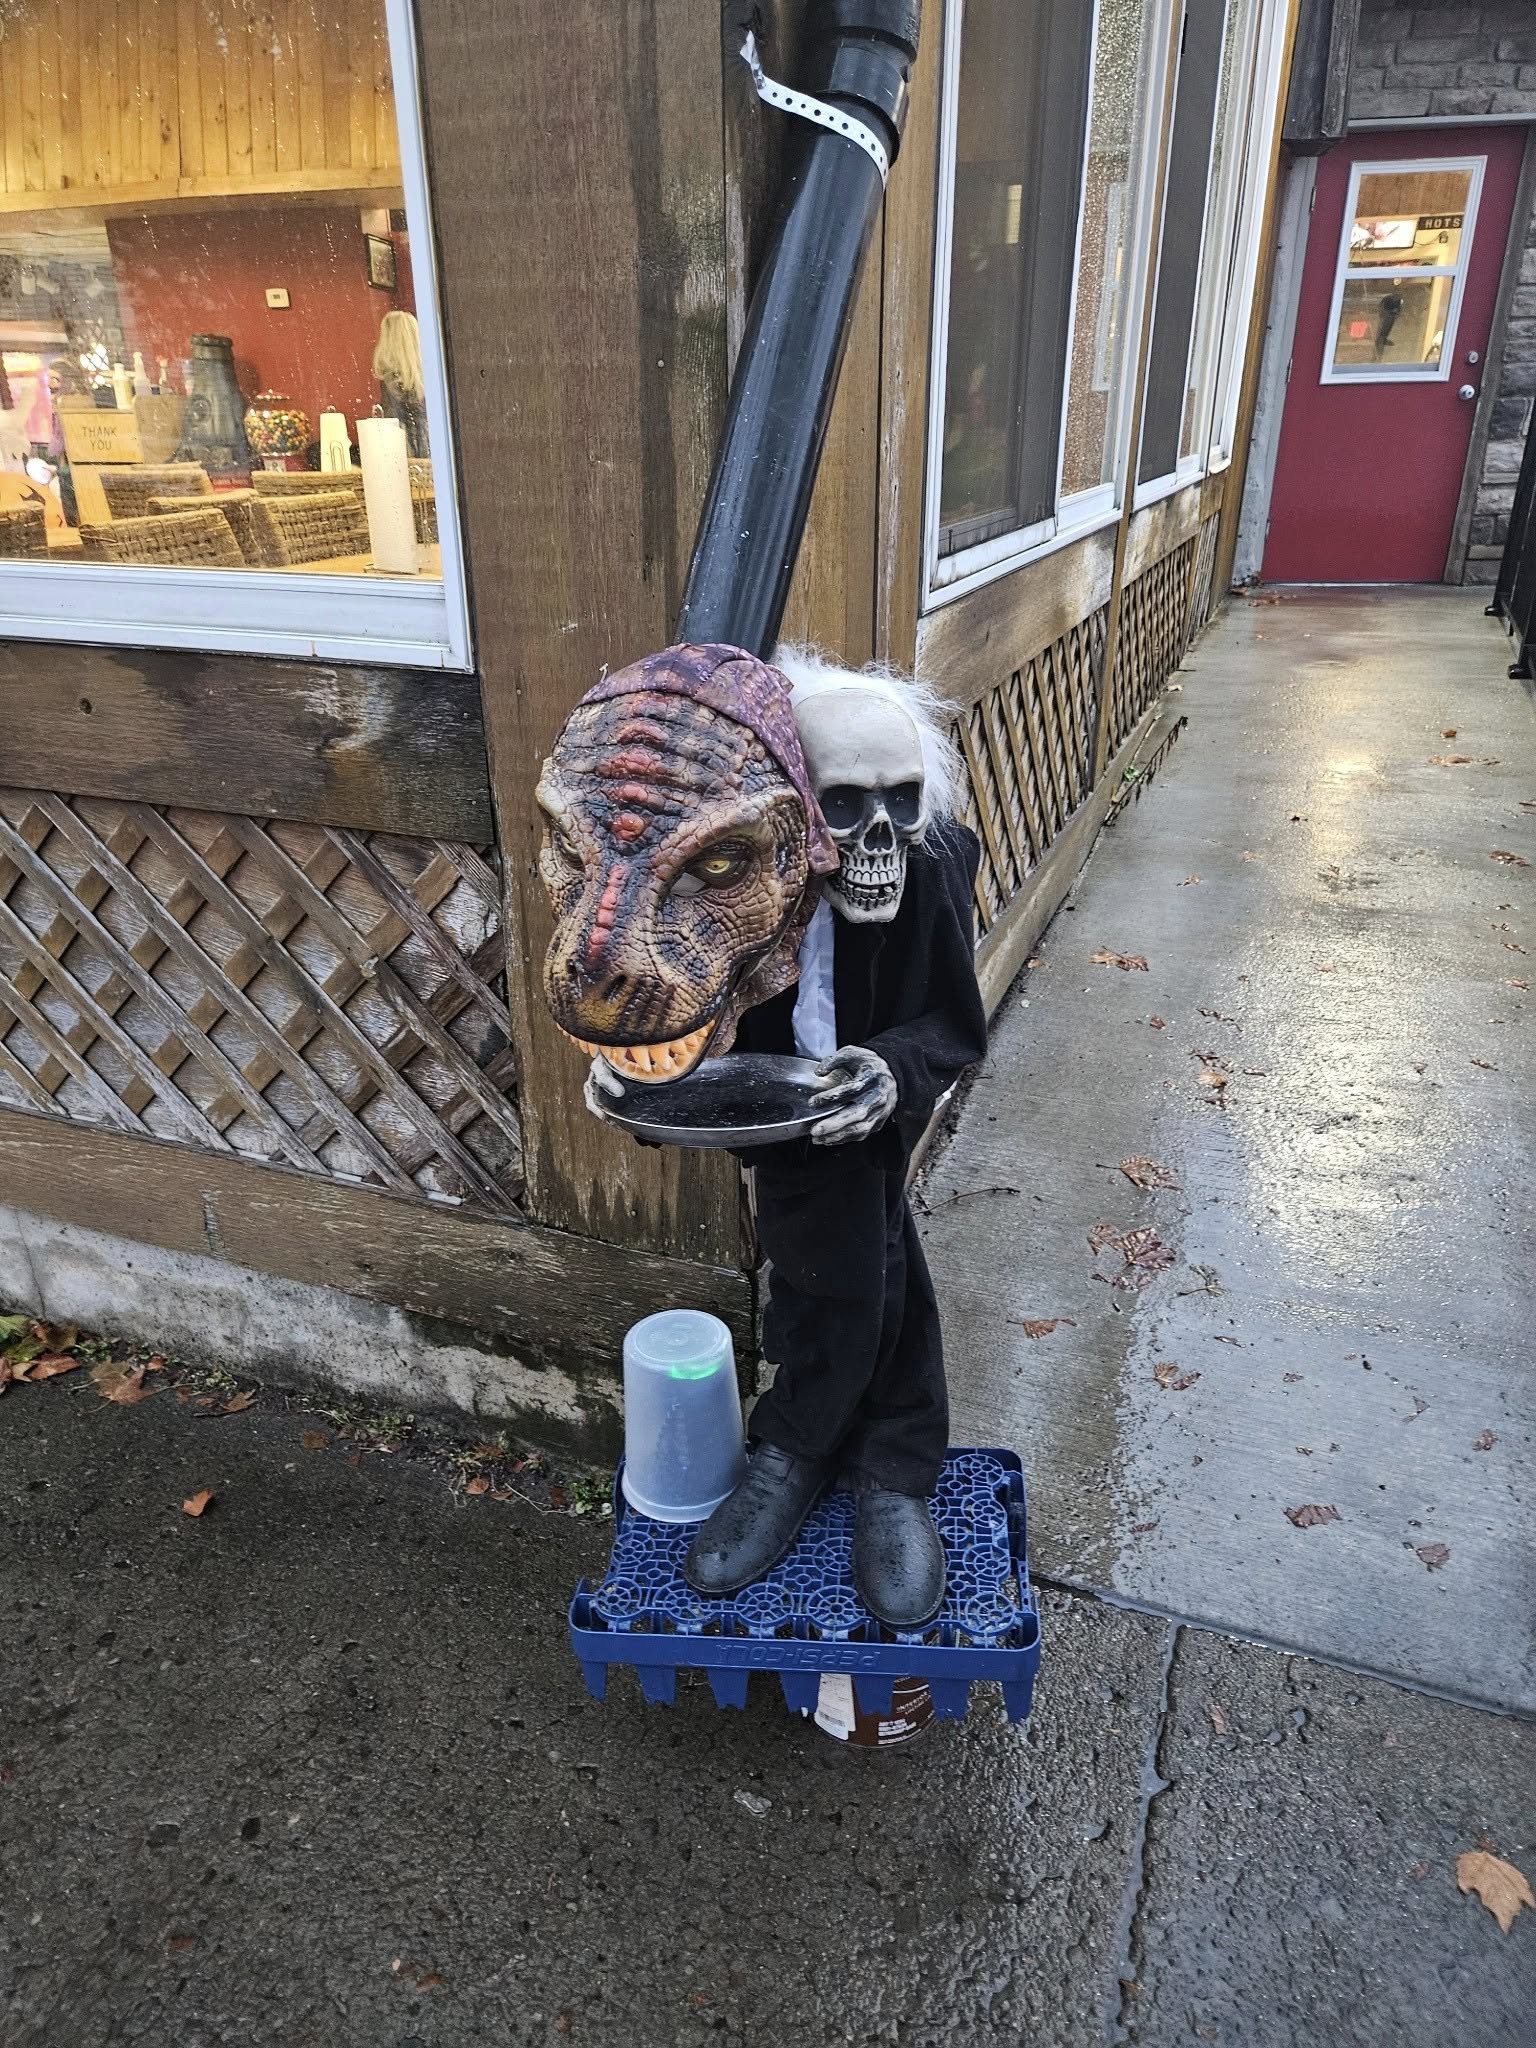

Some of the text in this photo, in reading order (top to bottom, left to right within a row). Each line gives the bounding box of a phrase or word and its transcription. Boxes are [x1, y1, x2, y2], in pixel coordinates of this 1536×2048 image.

[1425, 218, 1461, 229] HOTS
[82, 426, 117, 438] THANK
[90, 439, 112, 451] YOU
[715, 1644, 881, 1667] PEPSI-COLA
